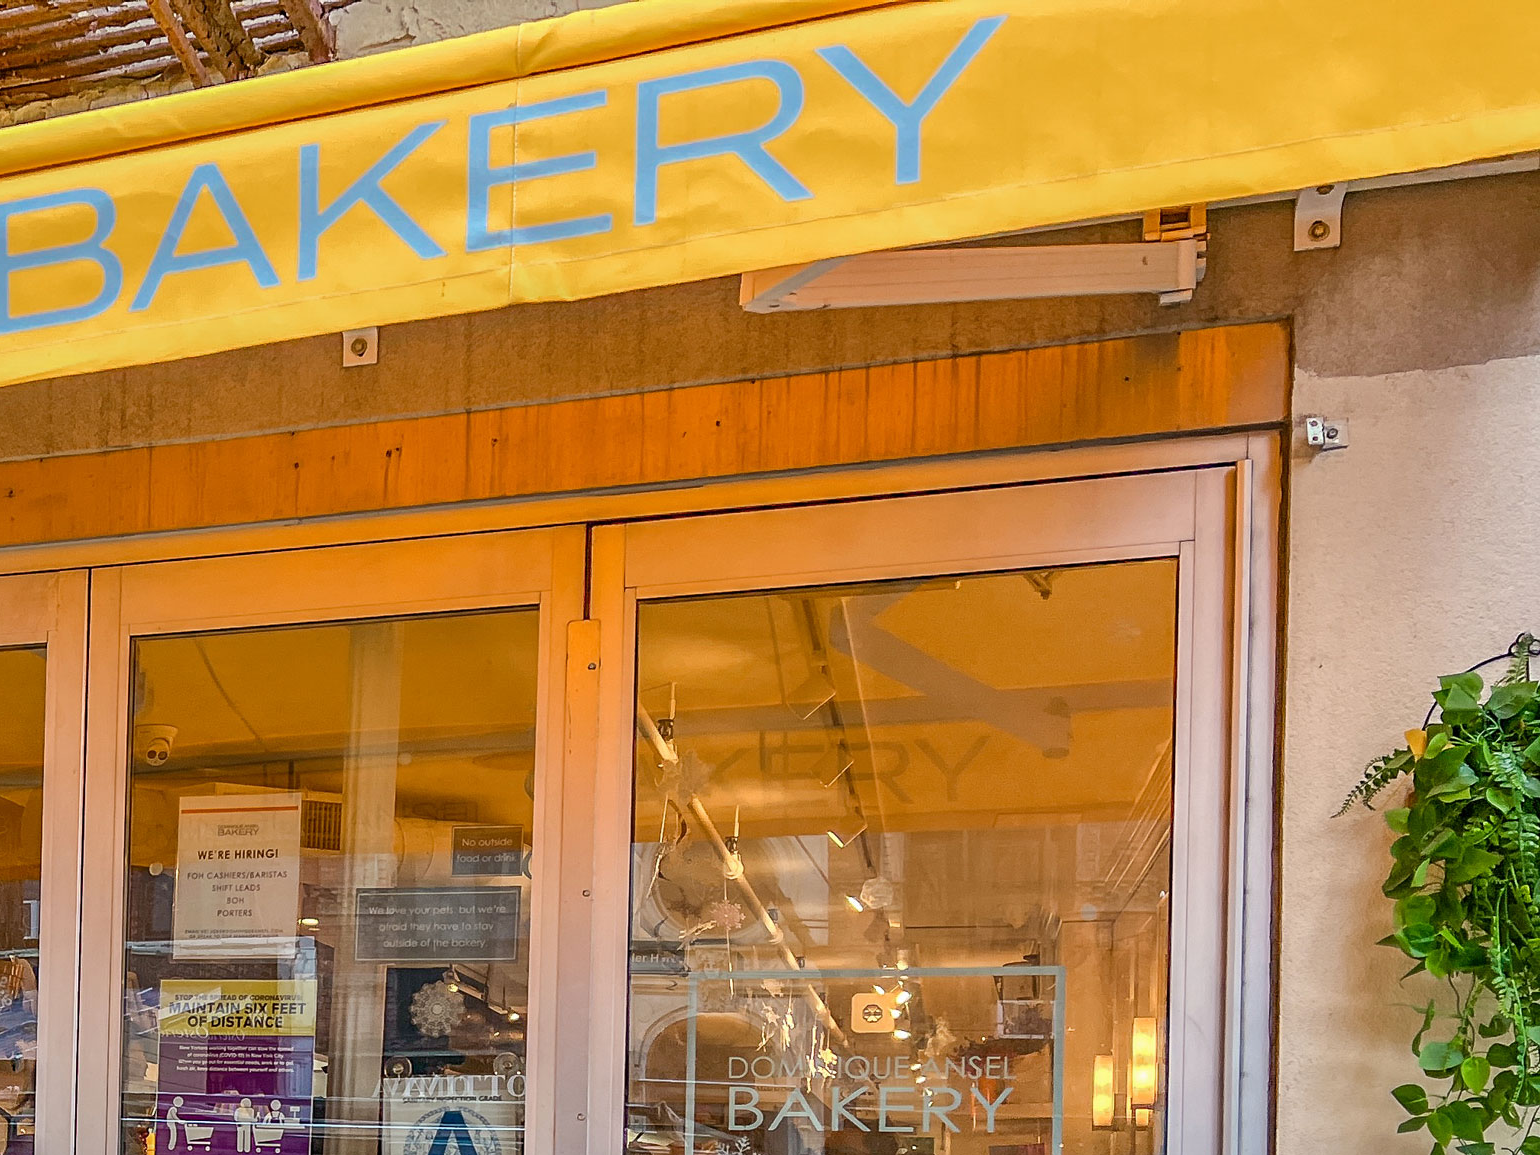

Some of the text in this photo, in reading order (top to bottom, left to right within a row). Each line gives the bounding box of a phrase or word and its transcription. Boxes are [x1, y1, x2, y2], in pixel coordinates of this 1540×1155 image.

[462, 837, 513, 847] No outside
[198, 849, 279, 860] WE'RE HIRING!
[456, 854, 479, 862] food
[187, 871, 288, 880] FOH CASHIERS/BARISTAS
[212, 884, 232, 892] SHIFT
[217, 909, 253, 917] PORTERS
[368, 907, 385, 915] We
[386, 906, 406, 915] love
[410, 908, 430, 916] your
[459, 905, 475, 914] but
[477, 905, 507, 913] we're
[379, 922, 494, 932] afraid they have to stay
[383, 939, 418, 948] outside
[420, 939, 431, 947] of
[434, 939, 449, 947] the
[169, 1003, 306, 1014] MAINTAIN SIX FEET
[187, 1016, 283, 1028] OF DISTANCE
[923, 1055, 1017, 1080] ANSEL
[728, 1086, 1015, 1133] BAKERY
